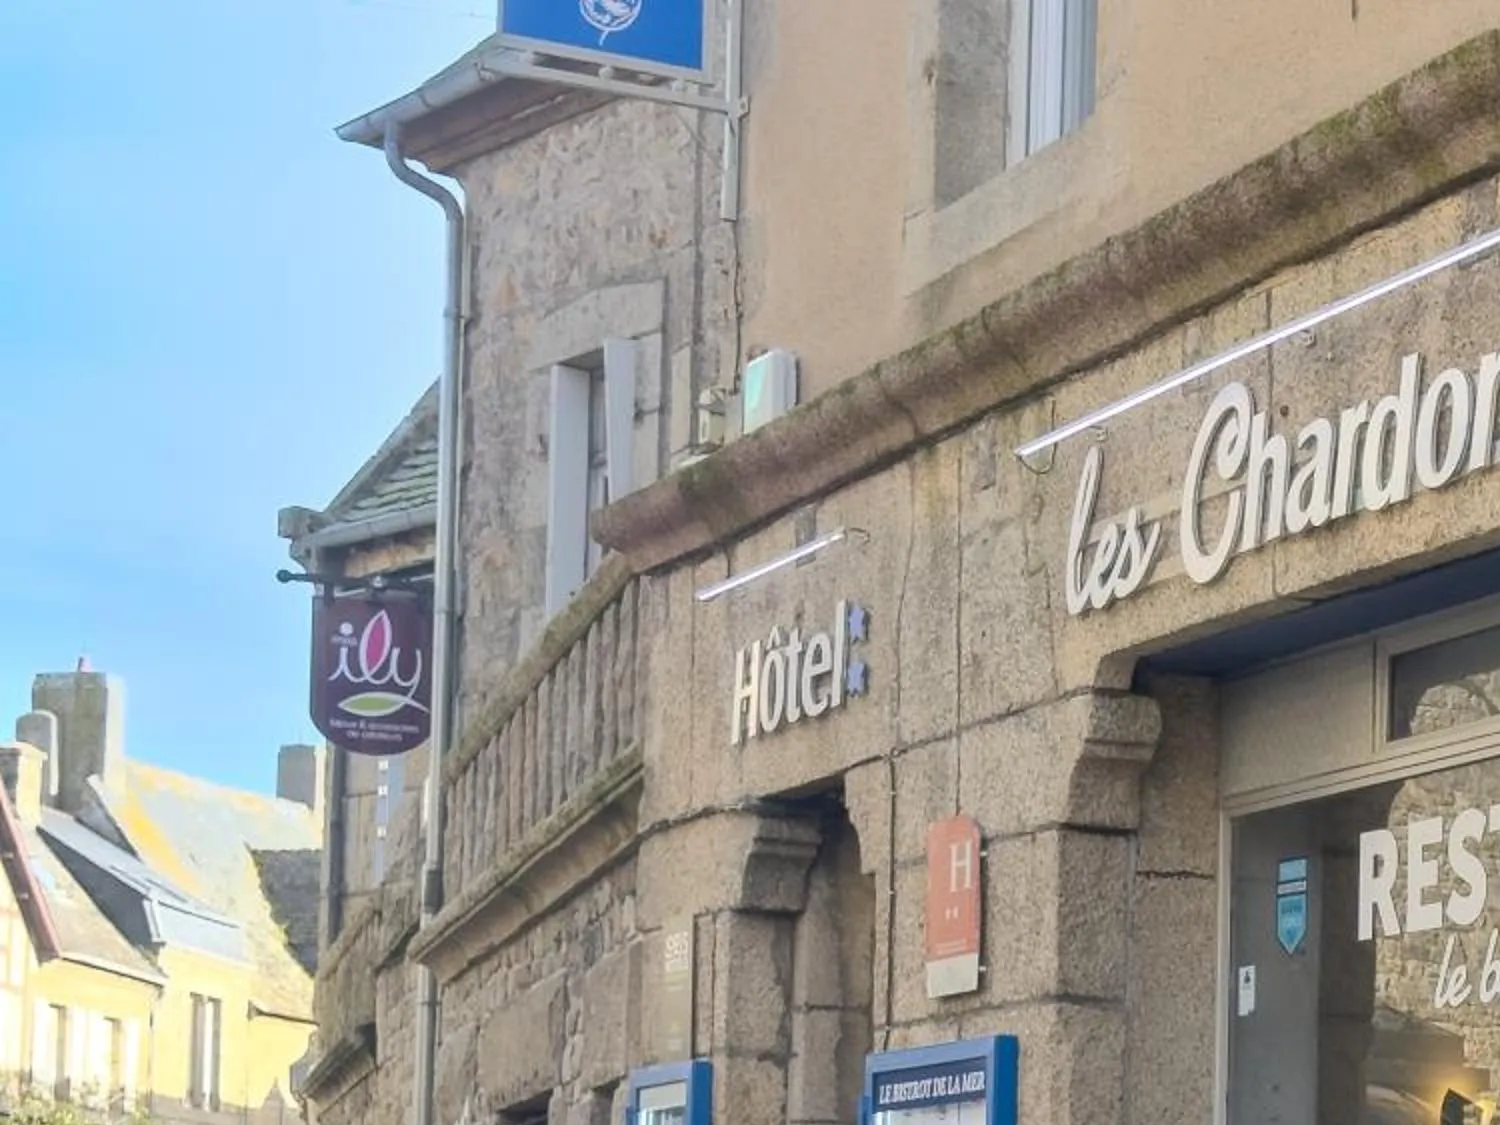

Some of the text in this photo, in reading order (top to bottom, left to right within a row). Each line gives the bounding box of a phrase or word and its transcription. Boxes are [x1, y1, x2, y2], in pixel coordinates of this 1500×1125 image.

[731, 600, 847, 745] Hôtel
[950, 840, 975, 893] H
[1434, 930, 1471, 1009] le
